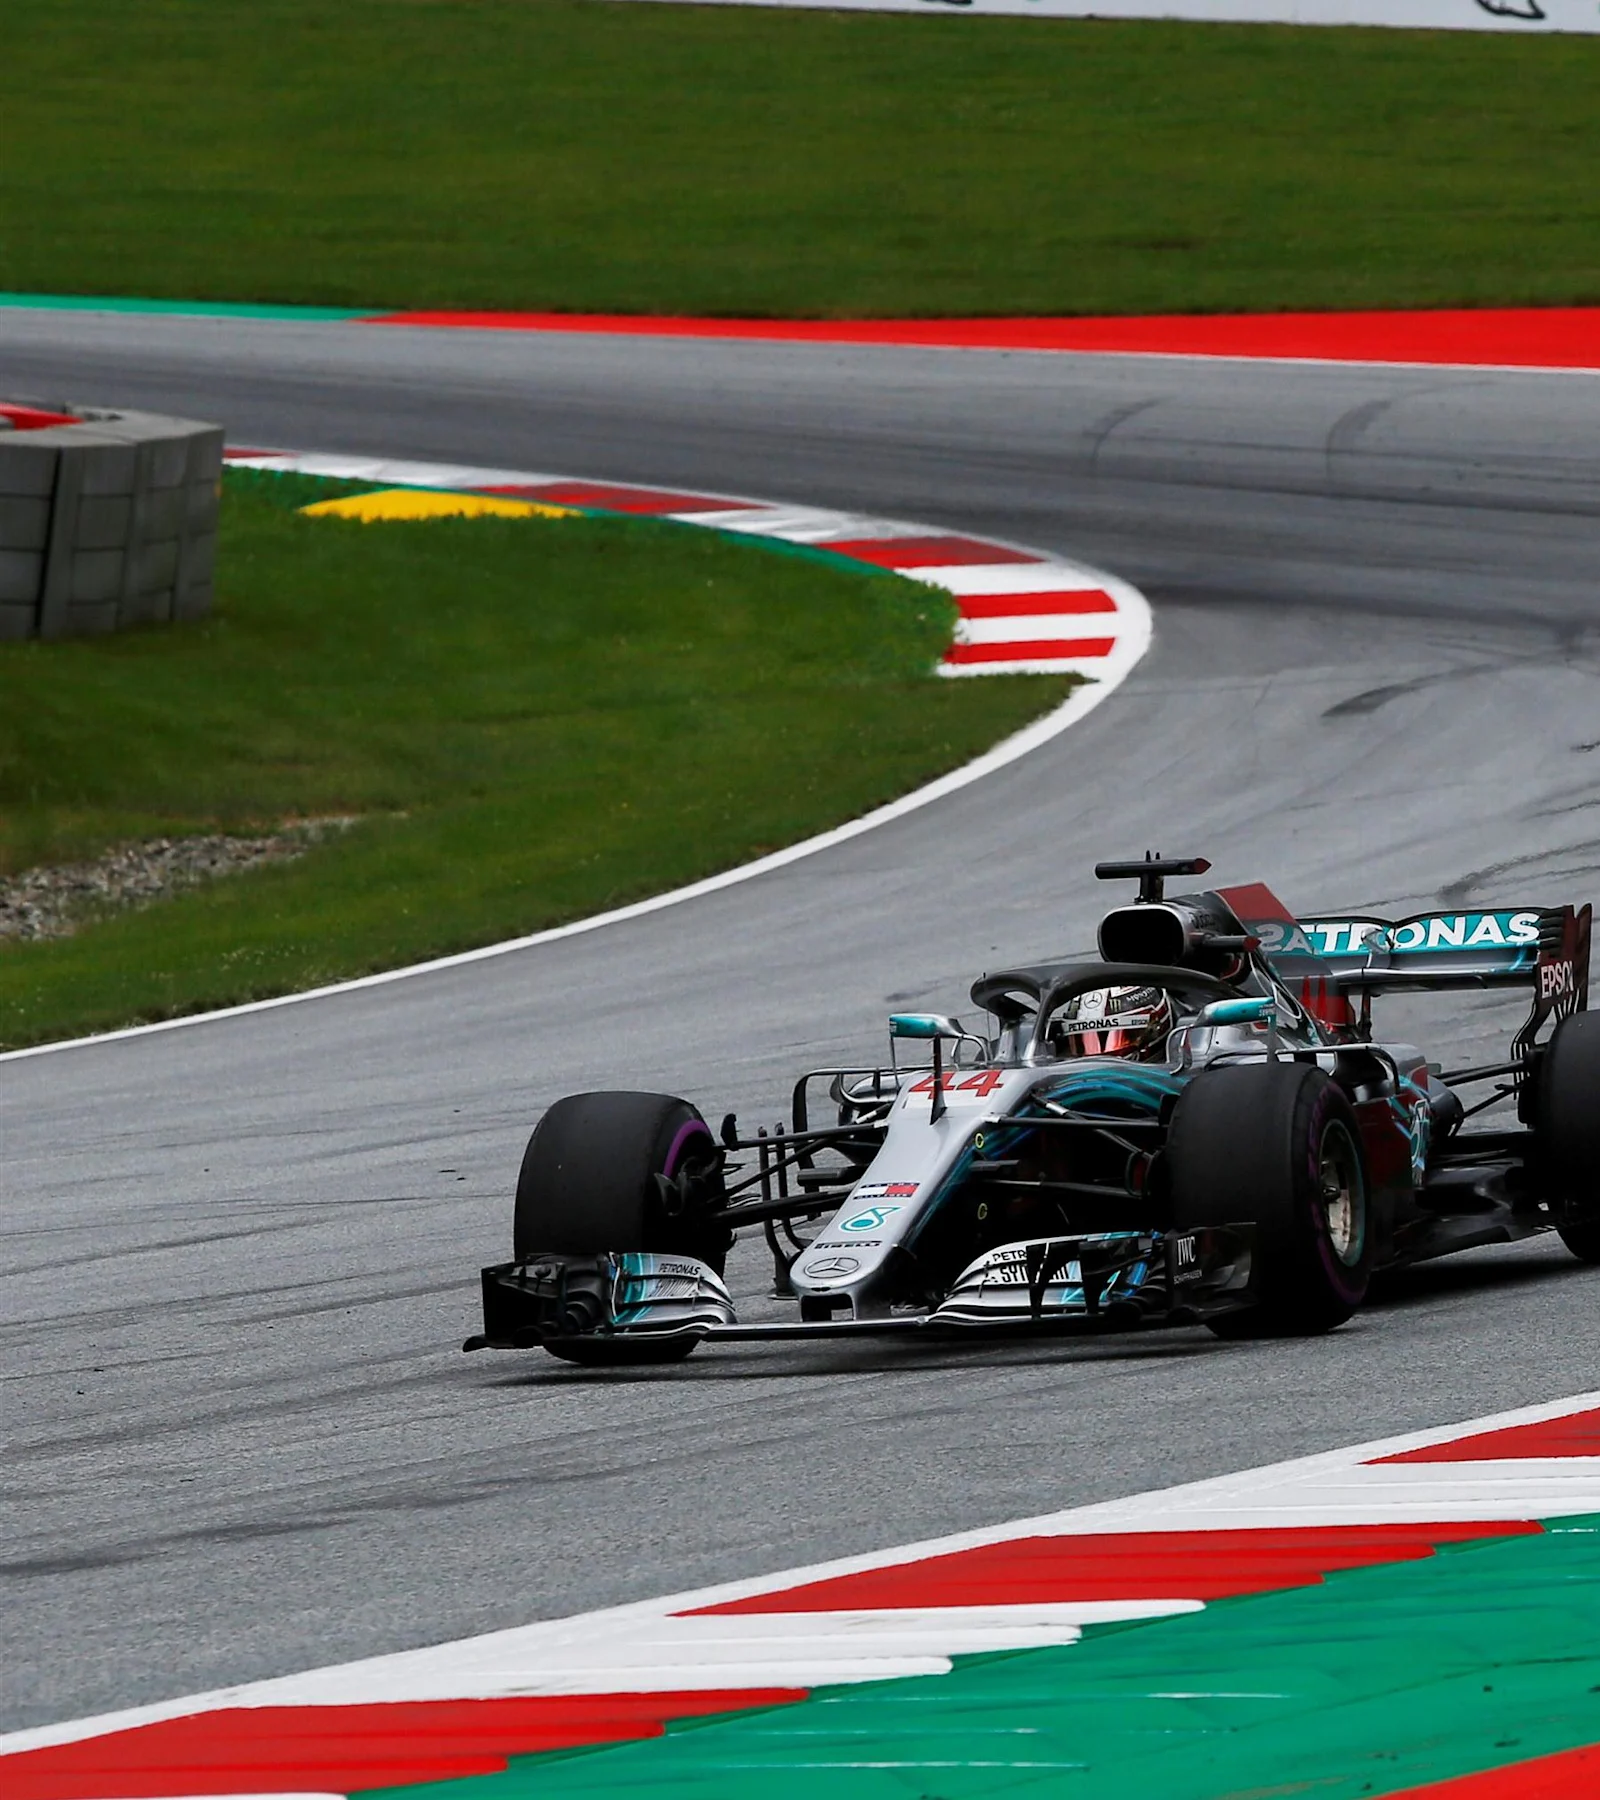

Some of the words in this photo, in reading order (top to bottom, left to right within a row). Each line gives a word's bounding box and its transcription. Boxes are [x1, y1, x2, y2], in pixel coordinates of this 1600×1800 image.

[1068, 1018, 1119, 1032] PETRONAS
[908, 1069, 1004, 1100] 44
[992, 1249, 1027, 1262] PETR
[659, 1263, 701, 1276] PETRONAS
